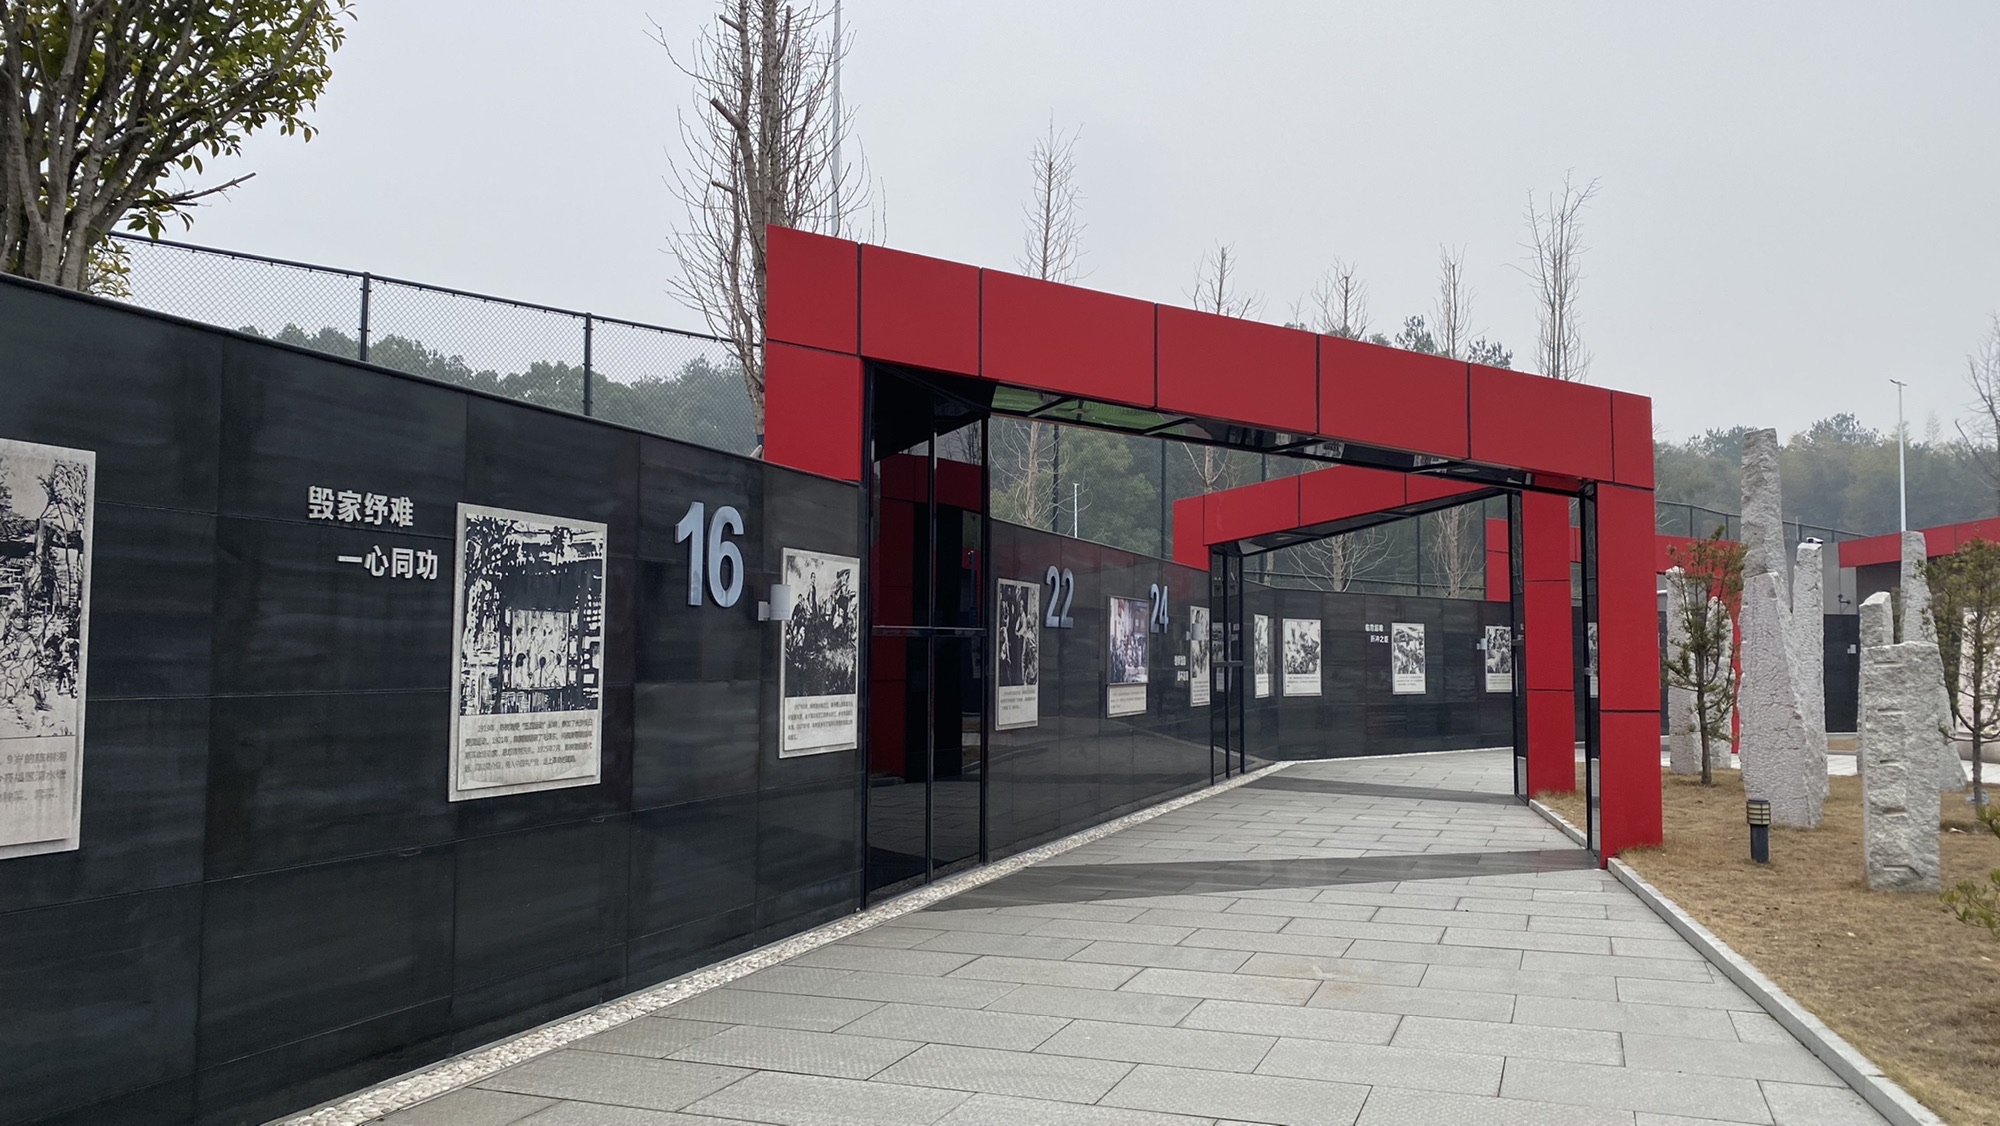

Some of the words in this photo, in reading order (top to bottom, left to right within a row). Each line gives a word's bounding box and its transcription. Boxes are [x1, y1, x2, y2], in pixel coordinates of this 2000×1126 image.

[308, 486, 414, 527] 毁家纾难
[337, 545, 438, 580] 一心同功
[675, 501, 745, 608] 16
[1045, 566, 1074, 629] 22
[1150, 583, 1169, 634] 24
